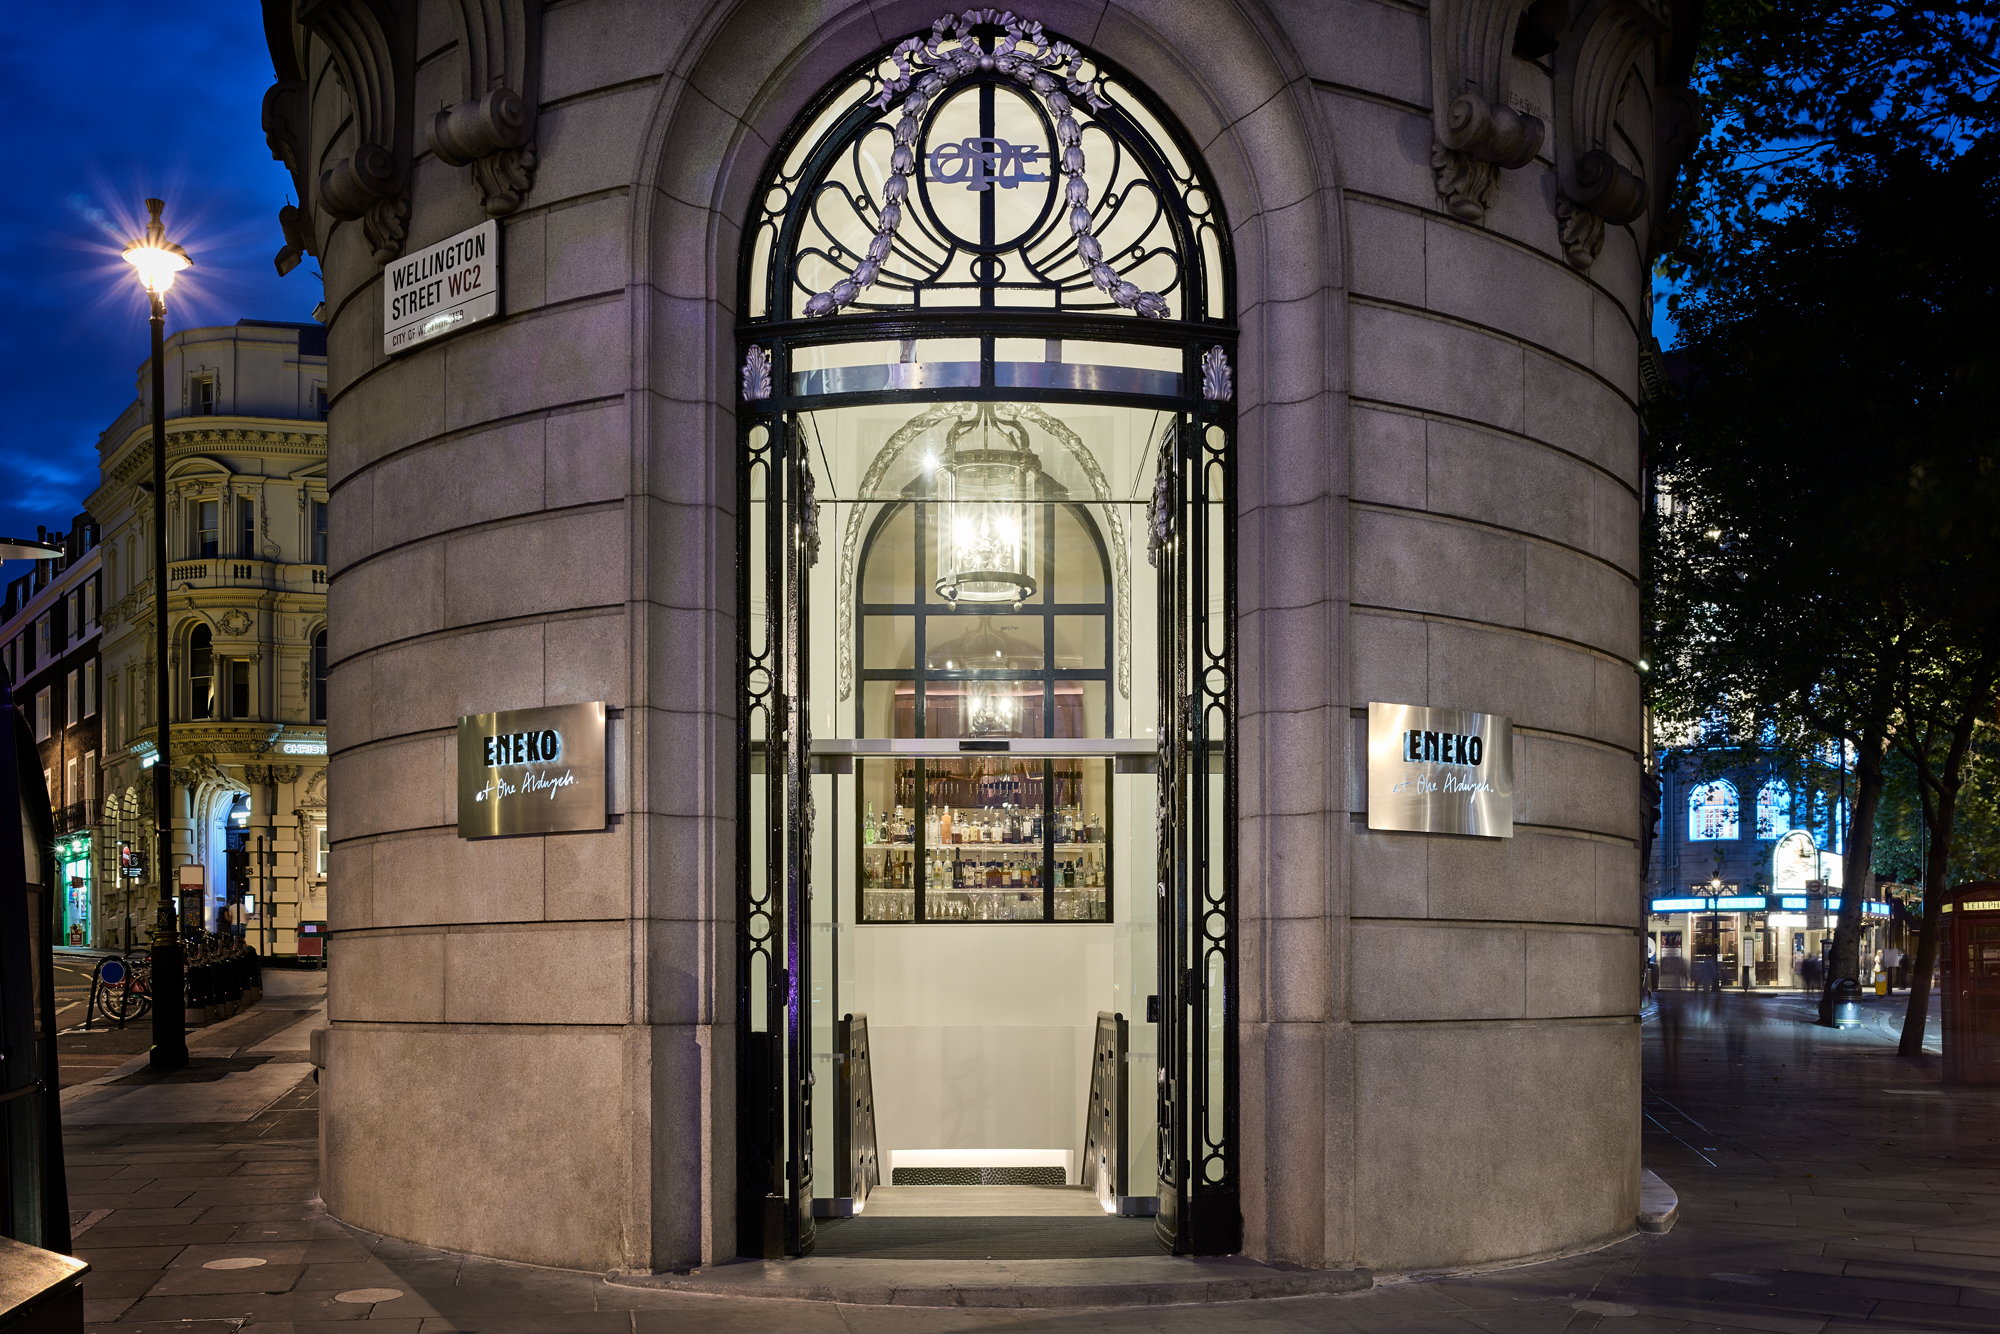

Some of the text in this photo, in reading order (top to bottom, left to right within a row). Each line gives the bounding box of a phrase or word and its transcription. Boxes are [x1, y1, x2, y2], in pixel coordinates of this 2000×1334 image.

[392, 232, 486, 292] WELLINGTON
[392, 264, 481, 321] STREET WC2
[392, 331, 406, 347] CITY
[408, 328, 416, 341] OF
[483, 729, 558, 767] ENEKO
[1408, 729, 1483, 766] ENEKO
[475, 779, 495, 802] at
[497, 778, 517, 799] One
[1392, 779, 1412, 793] at
[1416, 773, 1438, 795] One
